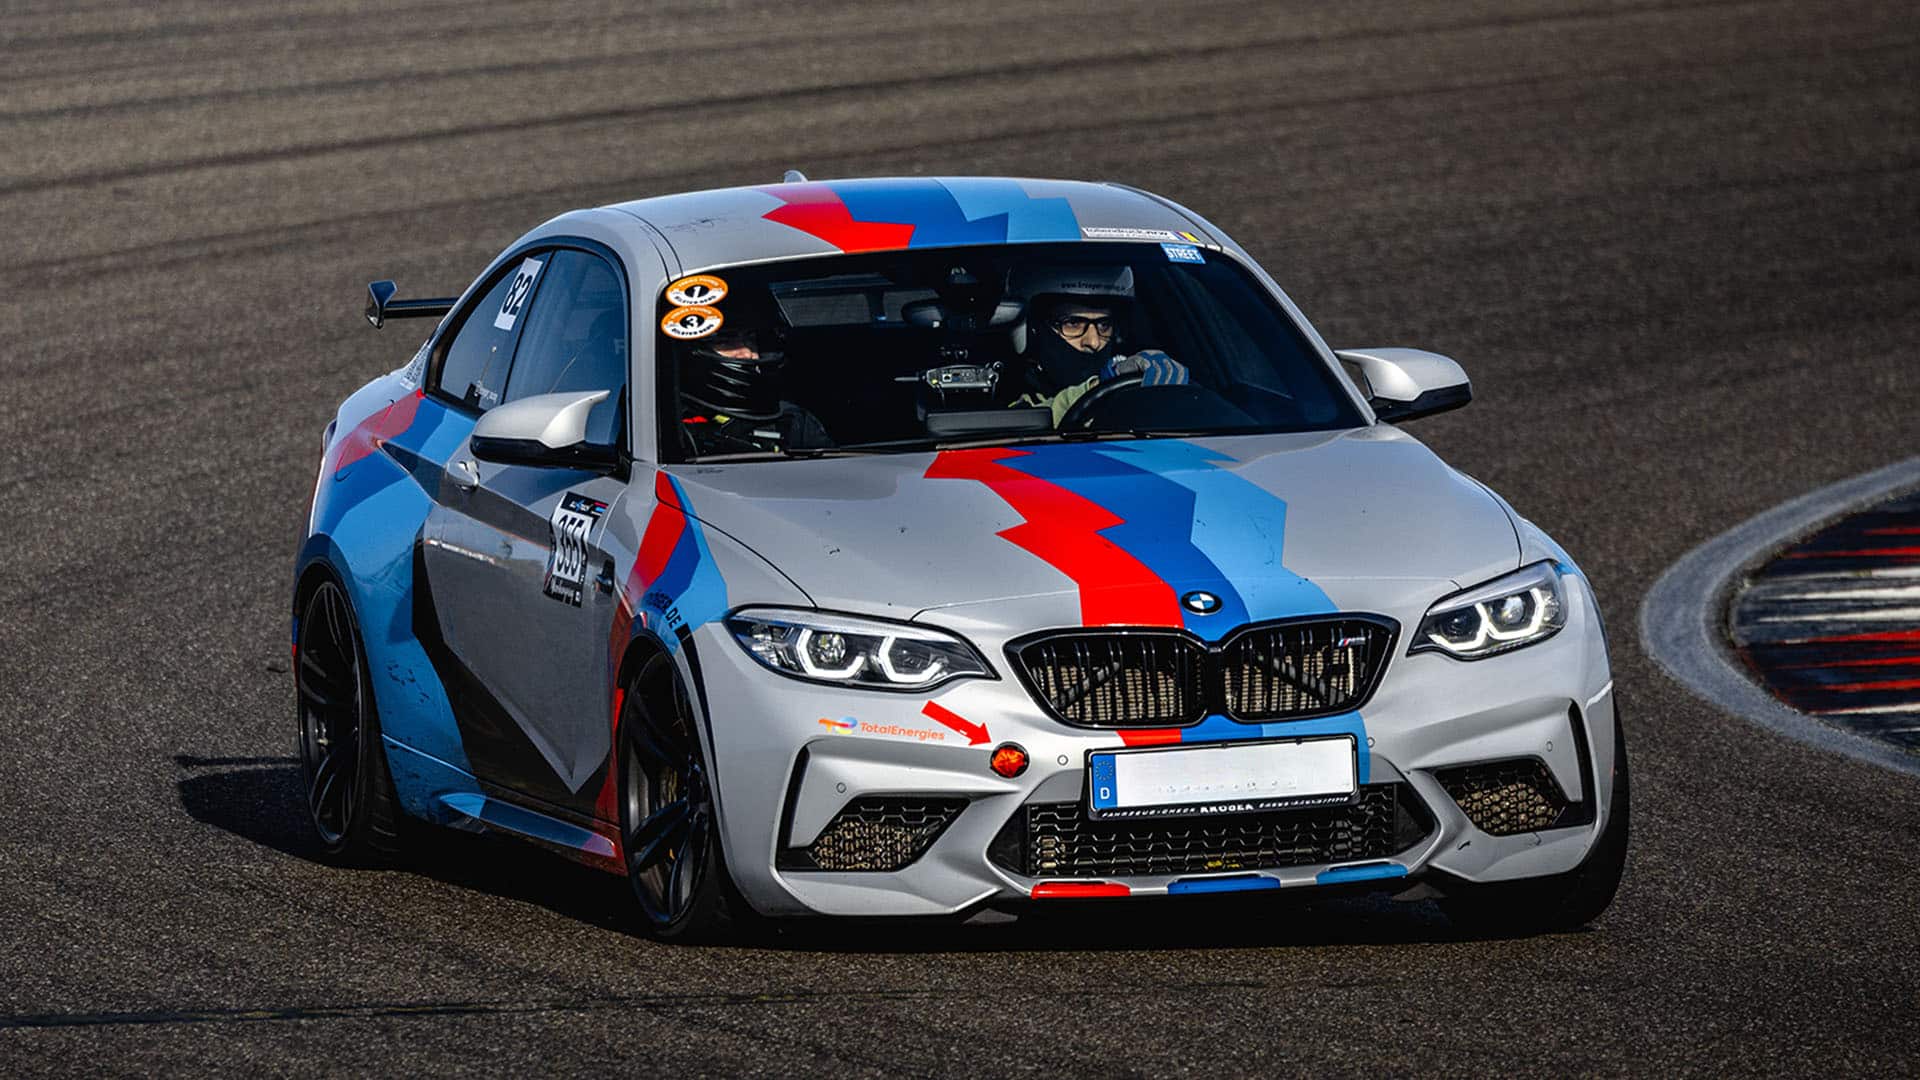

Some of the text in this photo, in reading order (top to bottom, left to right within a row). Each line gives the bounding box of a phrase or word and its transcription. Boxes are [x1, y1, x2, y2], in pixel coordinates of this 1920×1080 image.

[1167, 247, 1201, 261] STREET
[502, 272, 533, 315] 82
[692, 286, 702, 299] 1
[685, 315, 699, 329] 3
[860, 722, 945, 741] TotalEnergies
[1100, 786, 1111, 800] D
